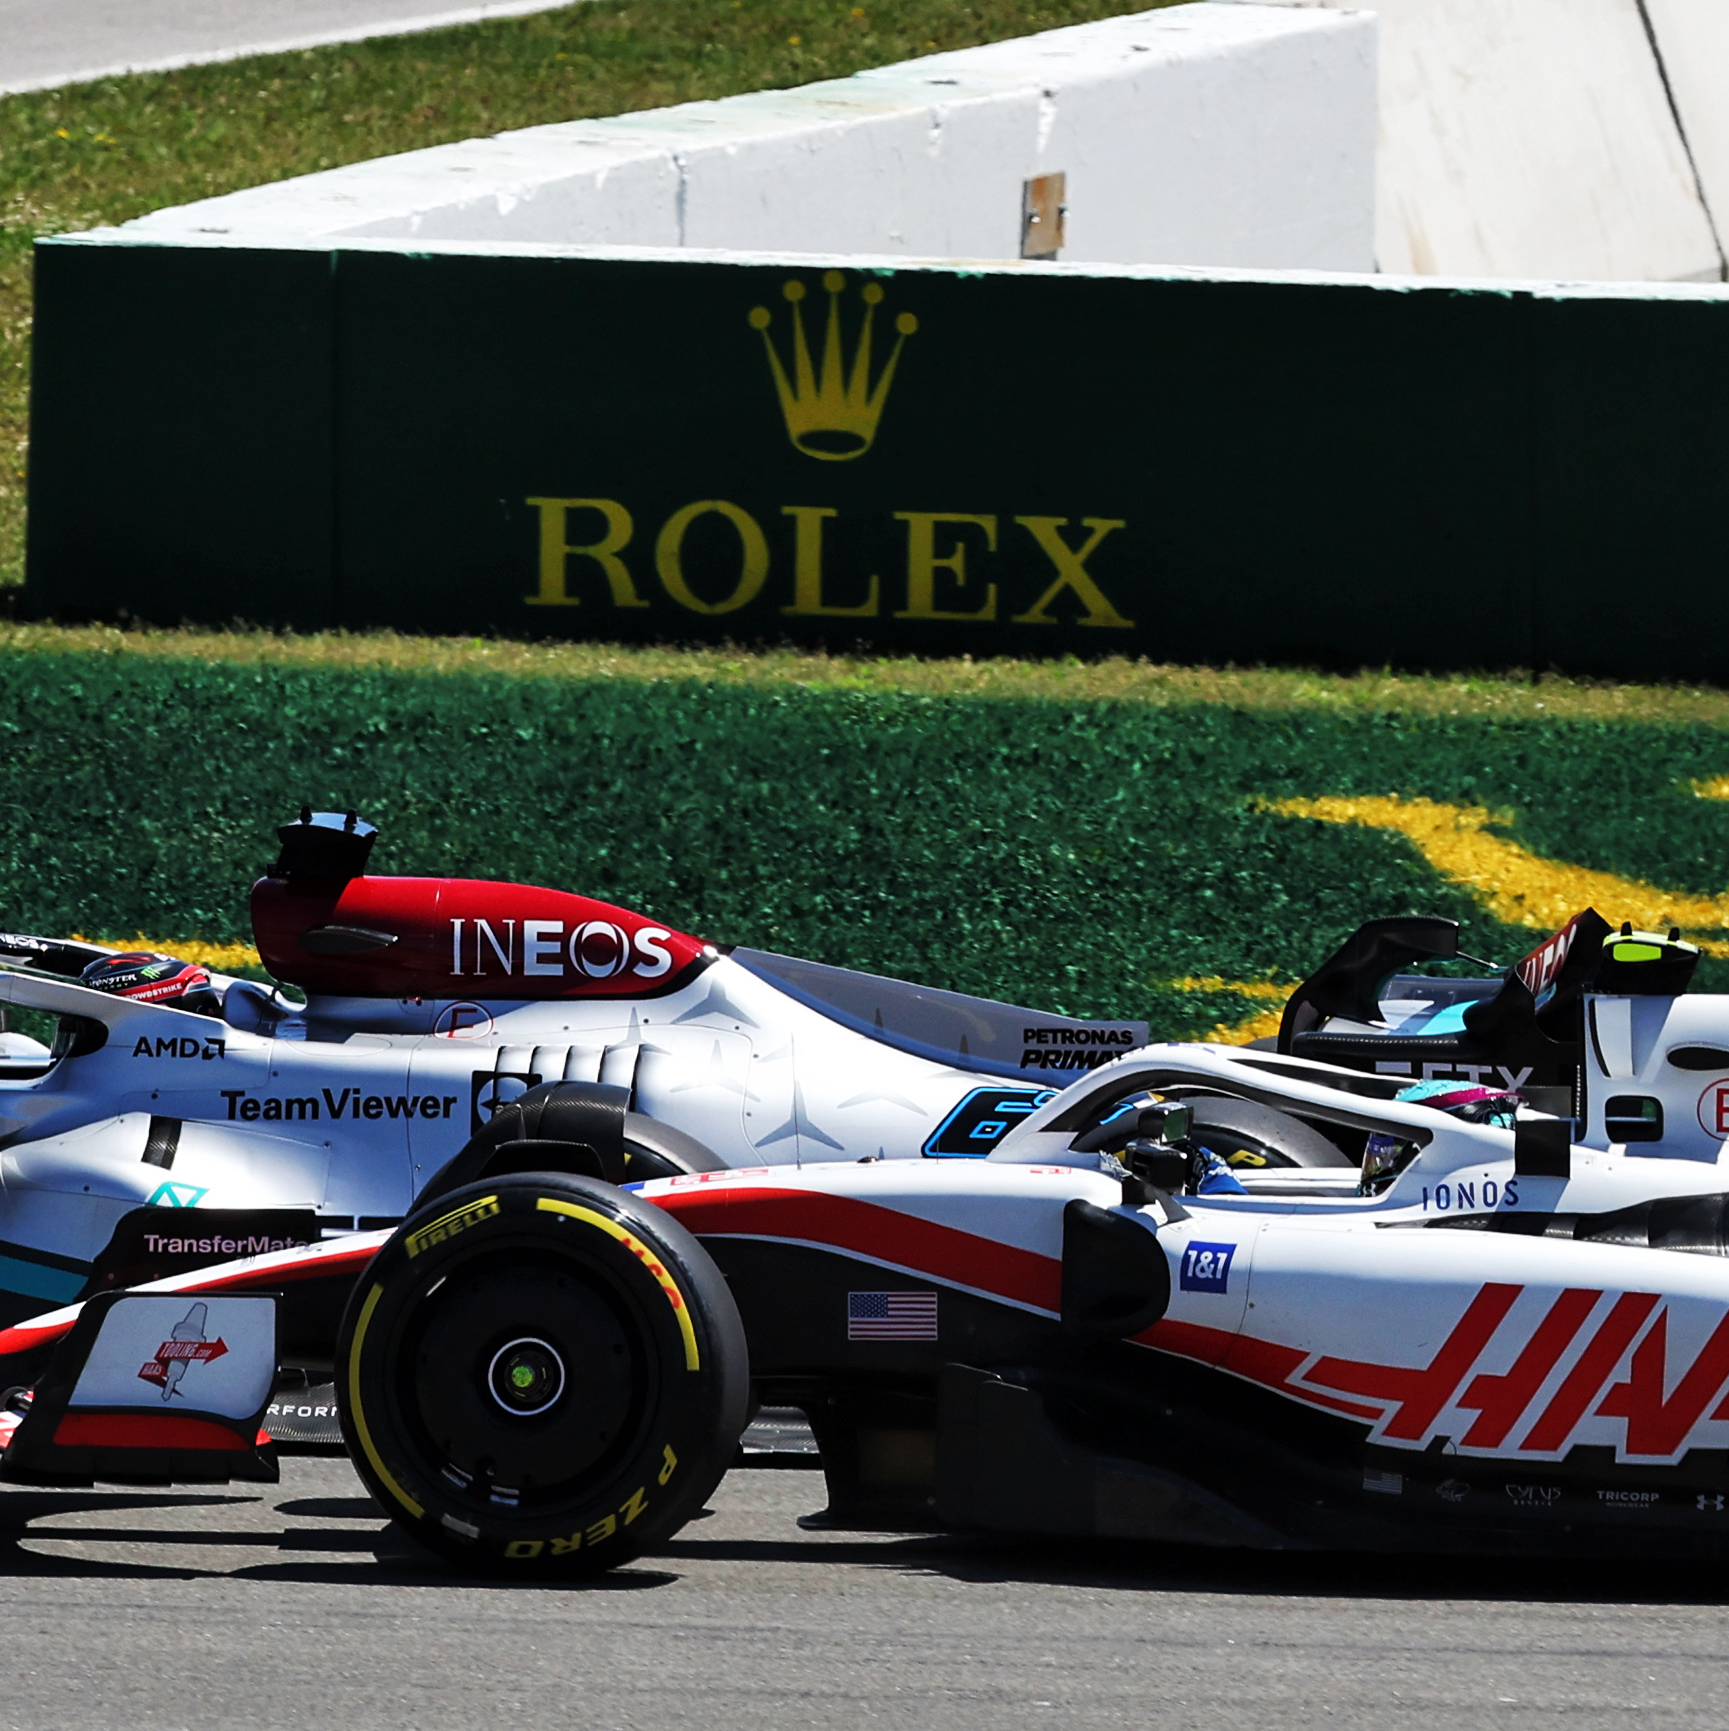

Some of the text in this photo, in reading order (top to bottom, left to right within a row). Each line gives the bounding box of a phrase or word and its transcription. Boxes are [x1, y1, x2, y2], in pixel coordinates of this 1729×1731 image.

[524, 495, 1135, 628] ROLEX
[450, 917, 673, 978] INEOS
[133, 1037, 199, 1058] AMD
[1023, 1028, 1133, 1044] PETRONAS
[221, 1088, 458, 1121] TeamViewer
[1423, 1179, 1519, 1211] IONOS
[405, 1195, 502, 1259] PIRELLI
[1186, 1249, 1229, 1280] 1&1
[504, 1444, 678, 1558] P ZERO
[1597, 1490, 1659, 1502] TRICORP
